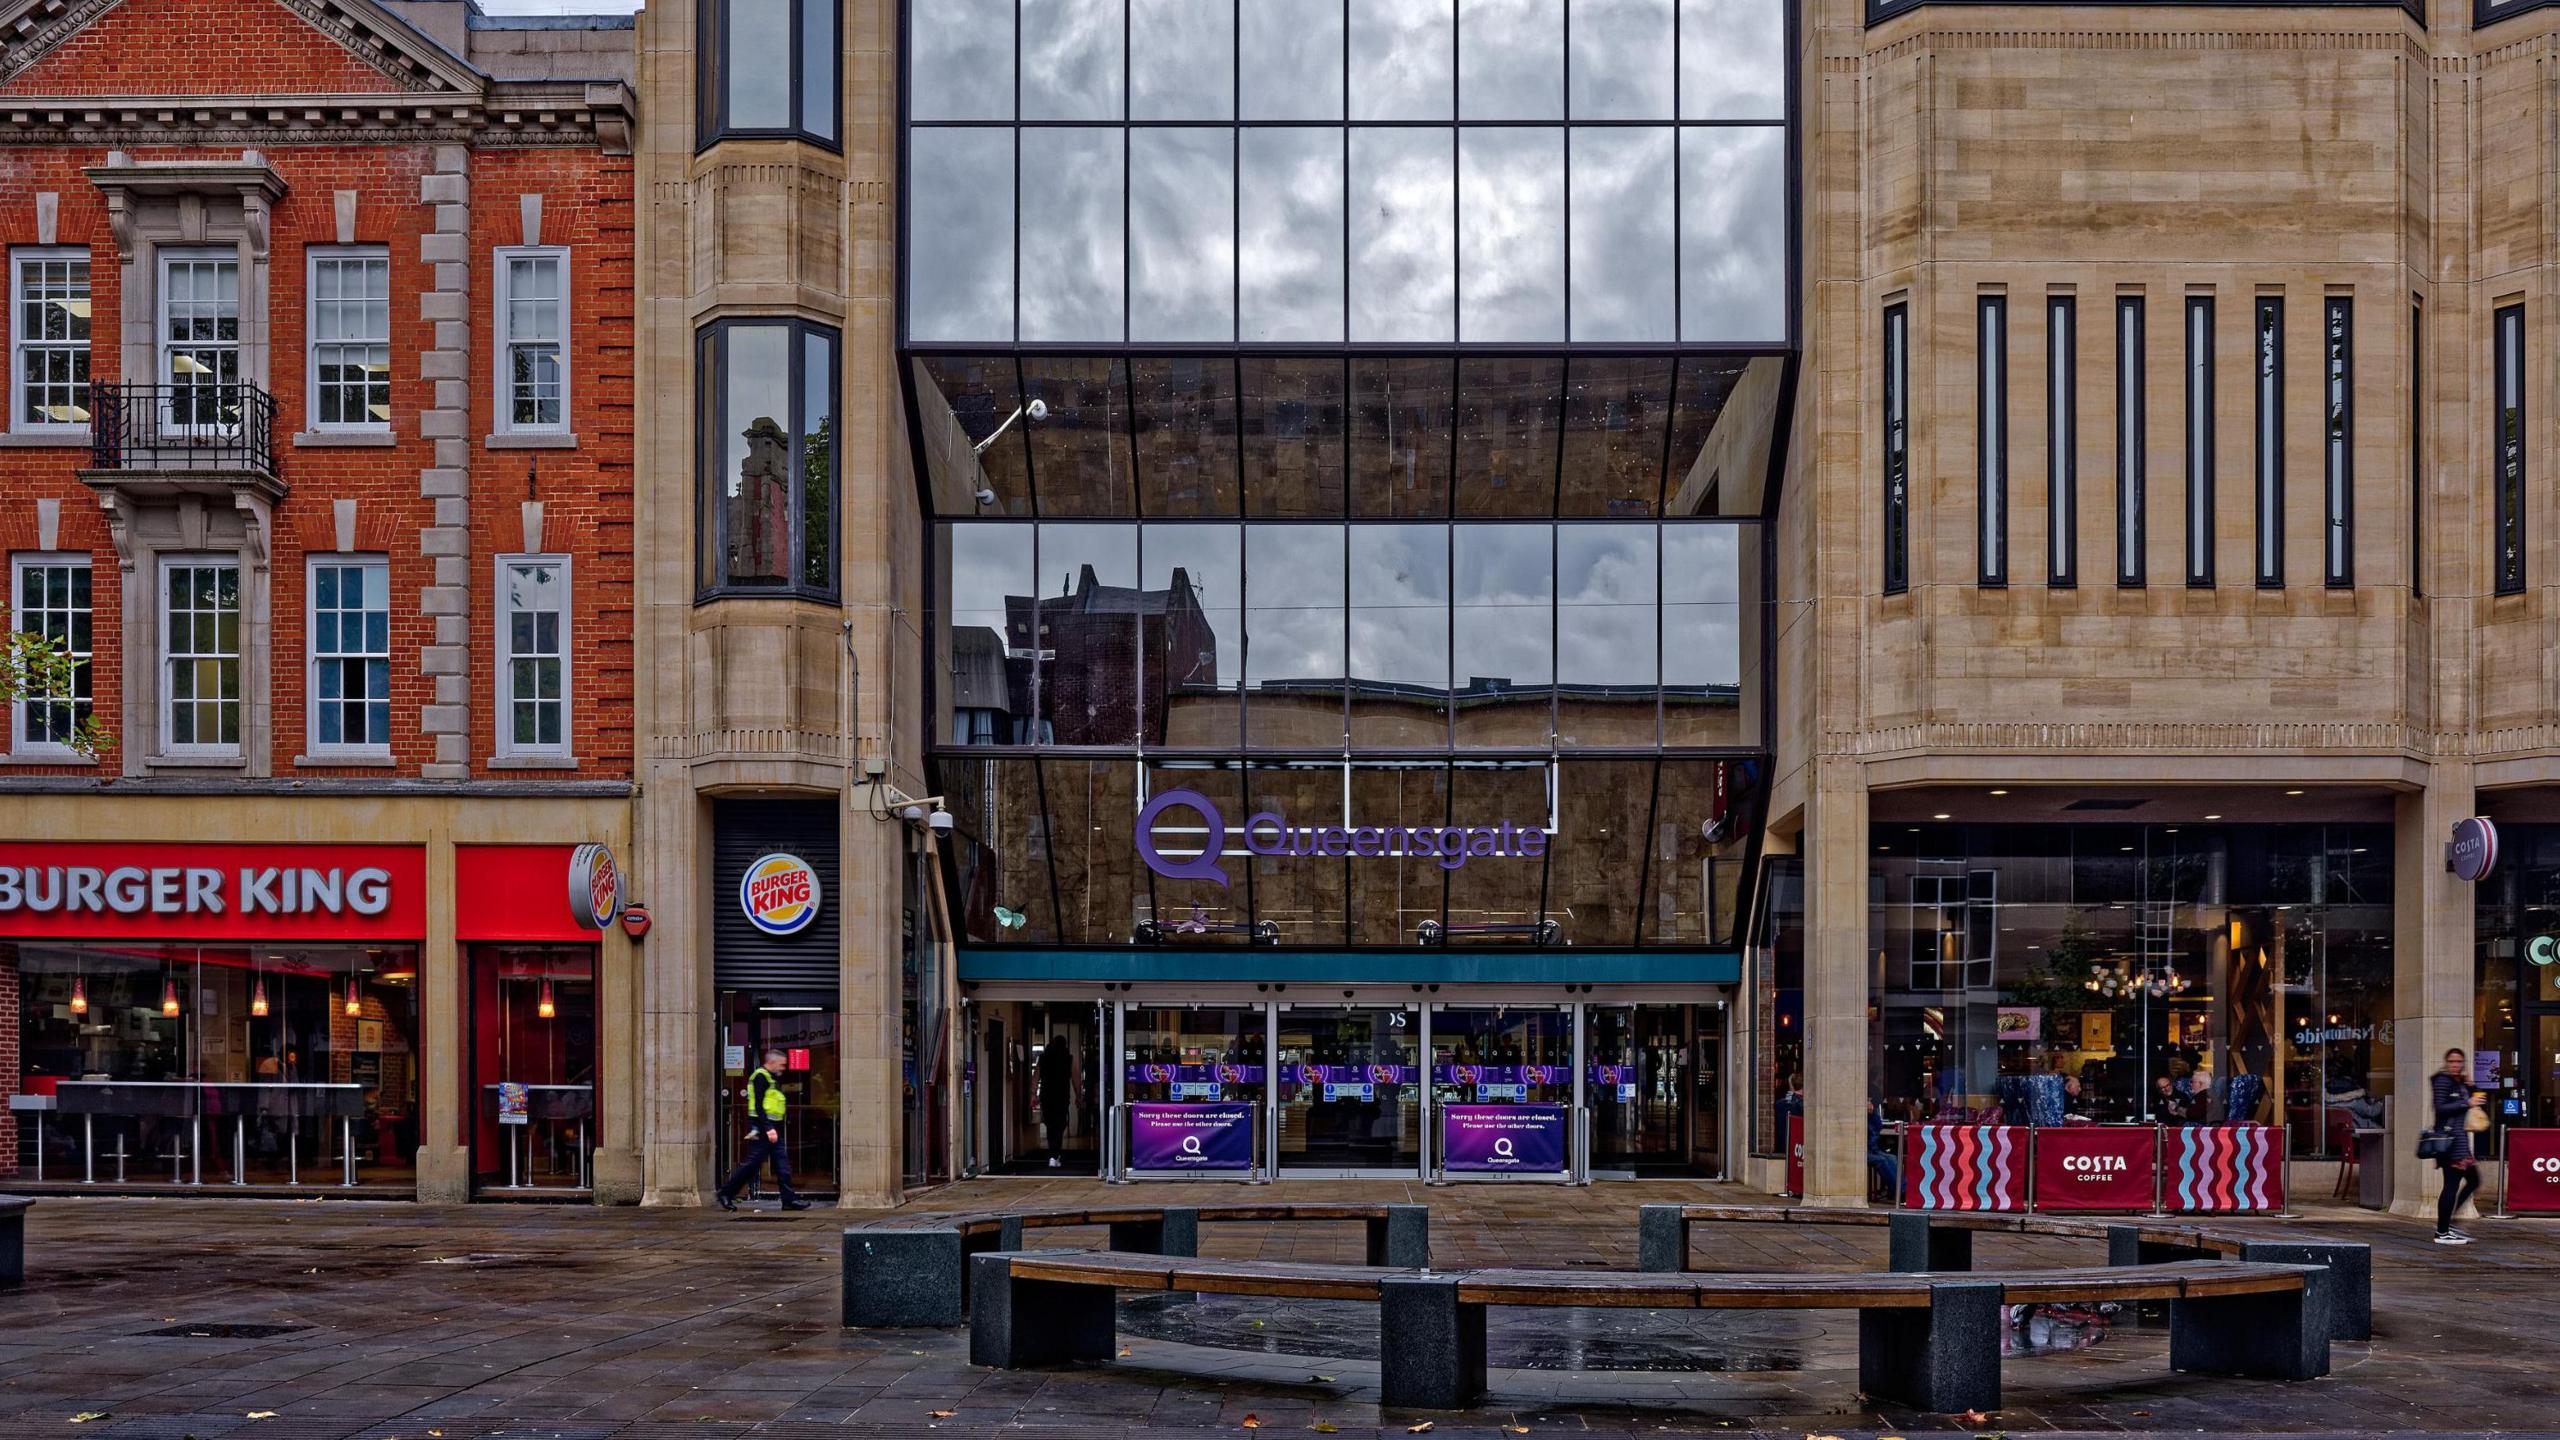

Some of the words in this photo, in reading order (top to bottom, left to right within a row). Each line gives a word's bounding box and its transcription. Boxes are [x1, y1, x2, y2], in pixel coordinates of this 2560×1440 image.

[1136, 788, 1229, 890] Q
[1244, 812, 1547, 870] Queensgate
[2455, 836, 2480, 854] COSTA
[0, 866, 227, 914] BURGER
[240, 866, 392, 915] KING
[592, 858, 612, 894] BURGER
[751, 870, 808, 896] BURGER
[593, 871, 615, 914] KING
[753, 883, 811, 915] KING
[1138, 1111, 1160, 1120] Sorry
[1162, 1111, 1182, 1119] these
[1183, 1111, 1204, 1119] doors
[1219, 1111, 1244, 1119] closed.
[1183, 1136, 1201, 1154] Q
[1494, 1137, 1513, 1157] Q
[2063, 1155, 2127, 1172] COSTA
